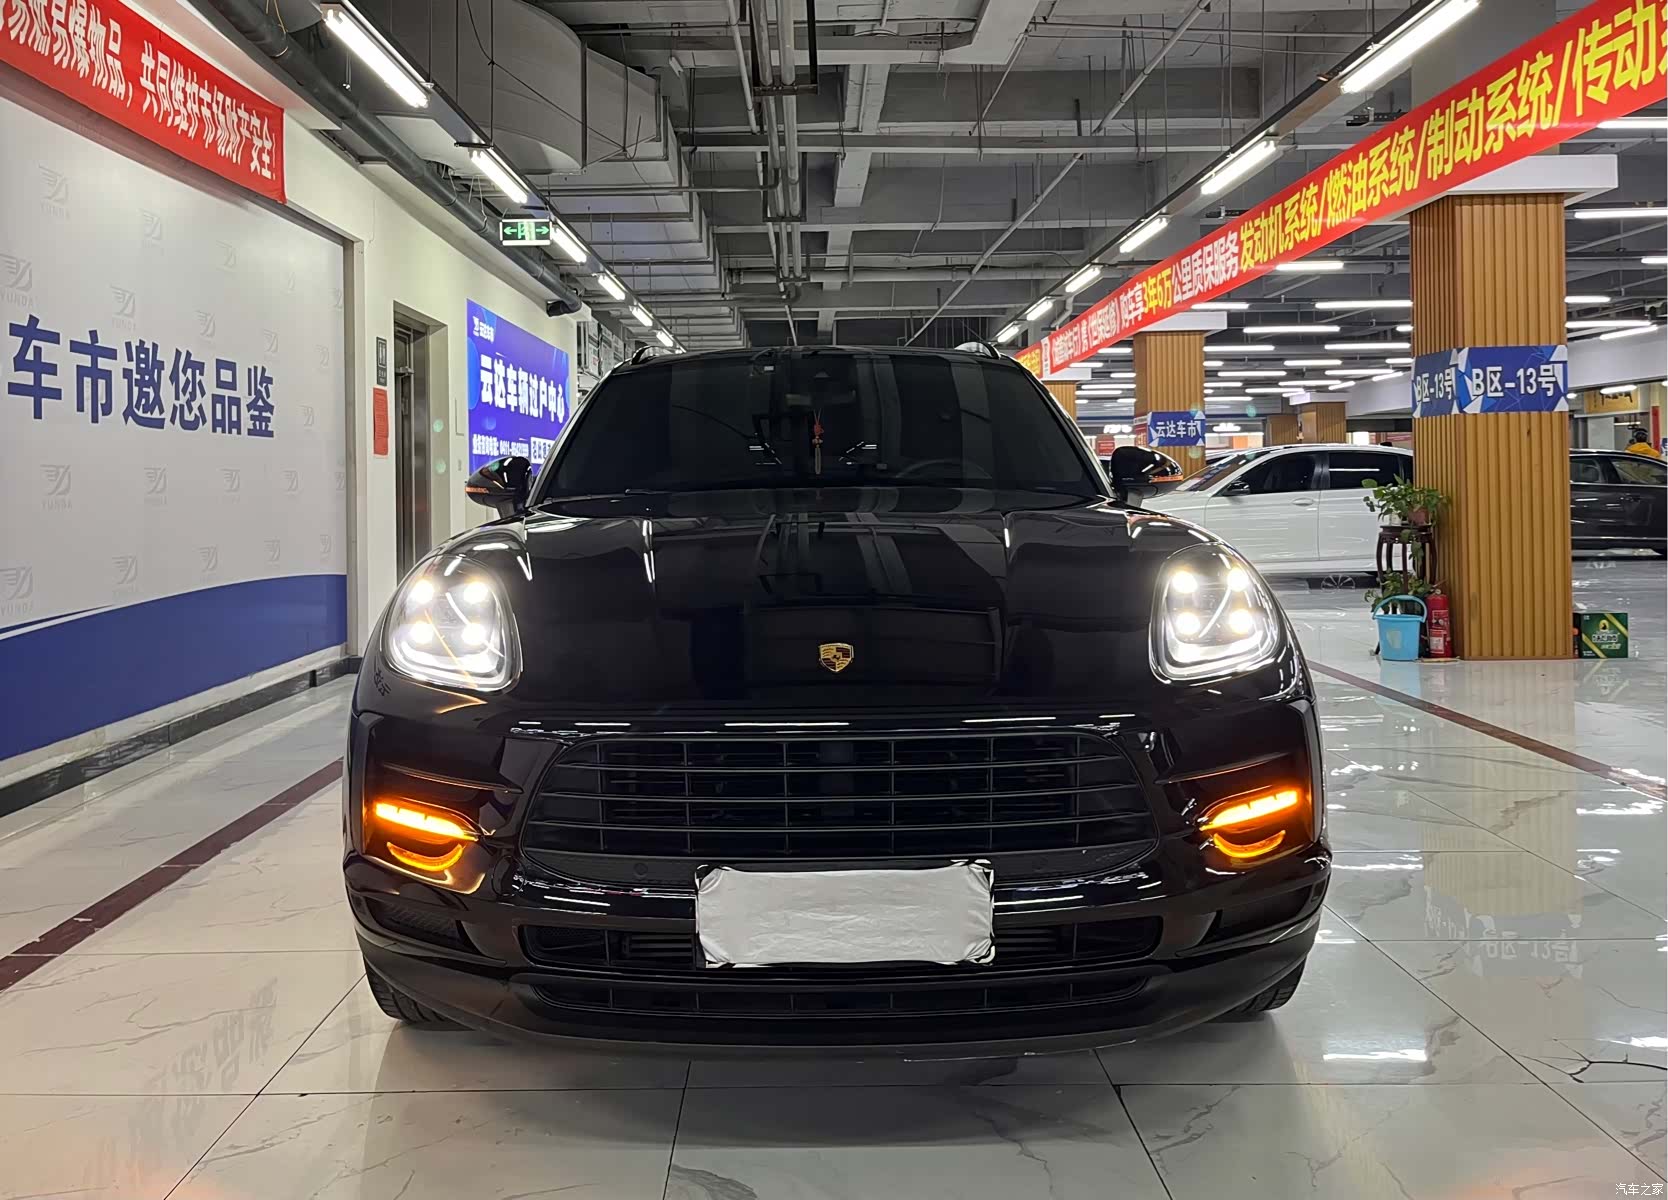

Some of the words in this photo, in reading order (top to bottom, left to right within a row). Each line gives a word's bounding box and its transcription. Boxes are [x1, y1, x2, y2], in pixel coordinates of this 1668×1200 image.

[7, 314, 275, 438] 车市邀您品鉴
[480, 353, 565, 423] 云达车辆过户中心
[1416, 369, 1452, 402] B区-13号
[1471, 365, 1556, 397] B区-13号
[1156, 420, 1198, 438] 云达车市
